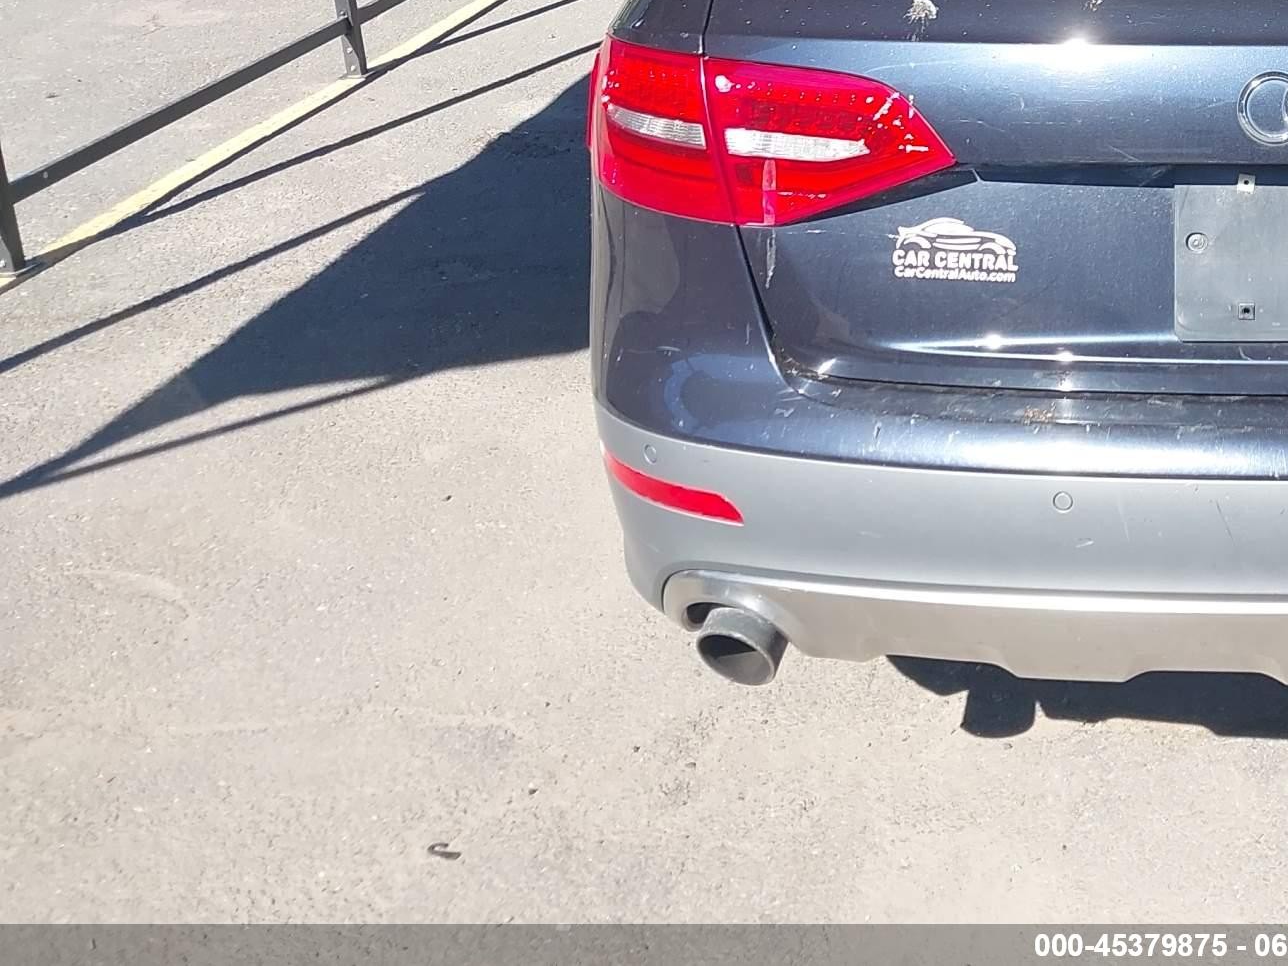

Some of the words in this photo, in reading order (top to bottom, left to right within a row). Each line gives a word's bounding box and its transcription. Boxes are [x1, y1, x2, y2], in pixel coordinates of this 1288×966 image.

[892, 249, 930, 267] CAR
[934, 251, 1018, 271] CENTRAL
[894, 266, 1016, 282] CarCentralAuto.com
